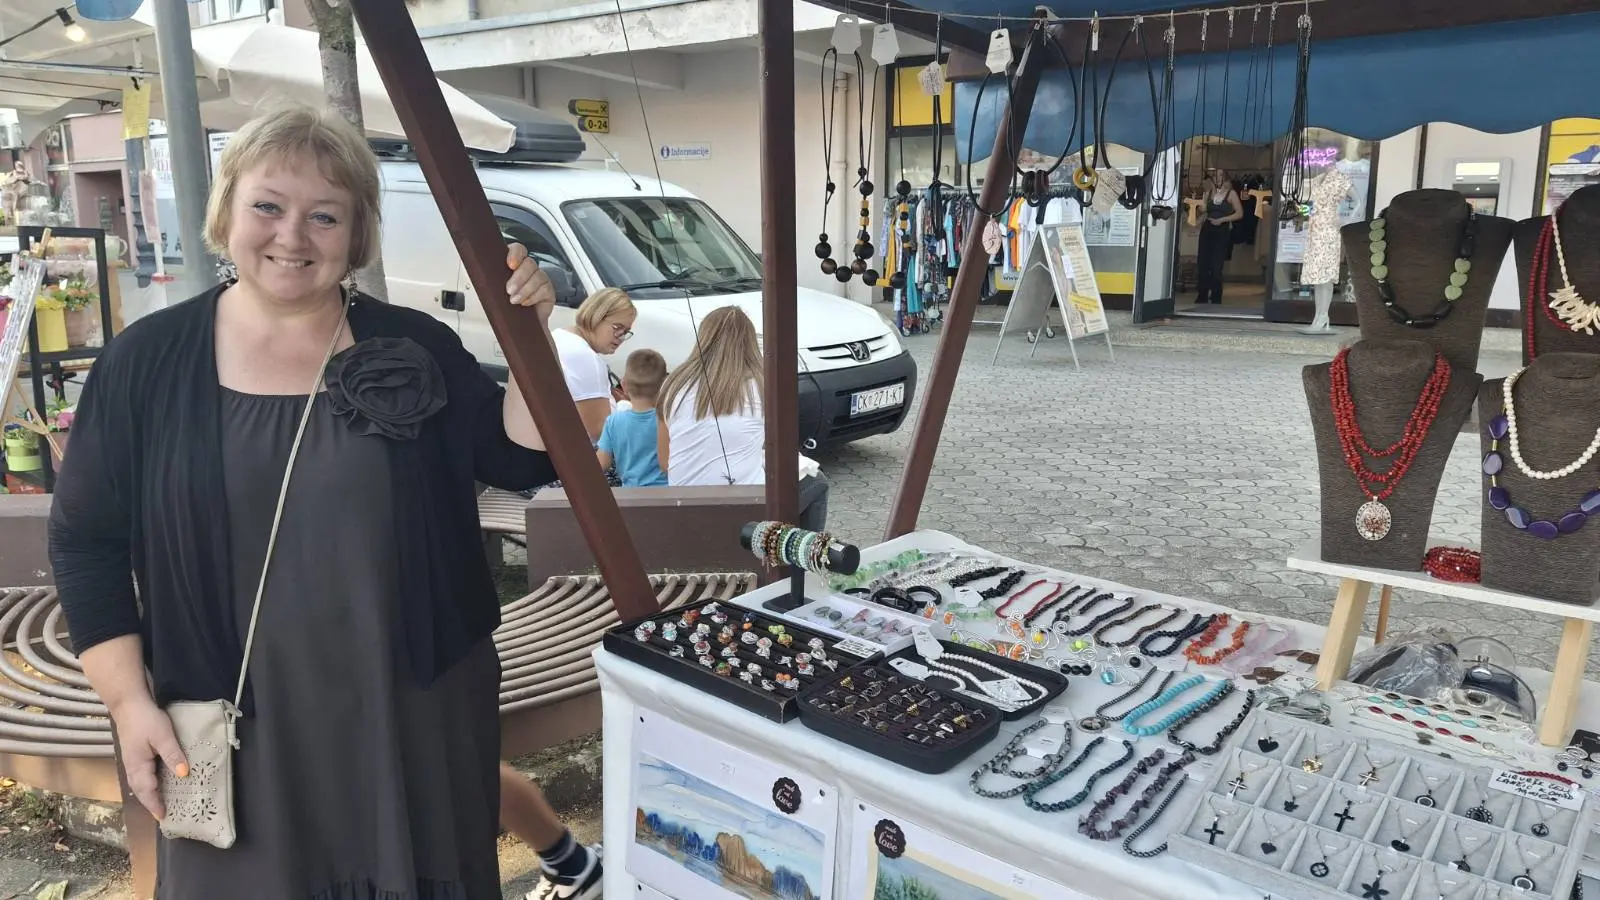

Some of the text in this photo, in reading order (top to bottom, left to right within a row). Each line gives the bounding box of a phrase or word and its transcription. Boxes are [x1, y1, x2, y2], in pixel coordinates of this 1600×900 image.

[588, 120, 608, 130] 0-24
[671, 146, 709, 157] Informacije
[878, 831, 898, 852] love
